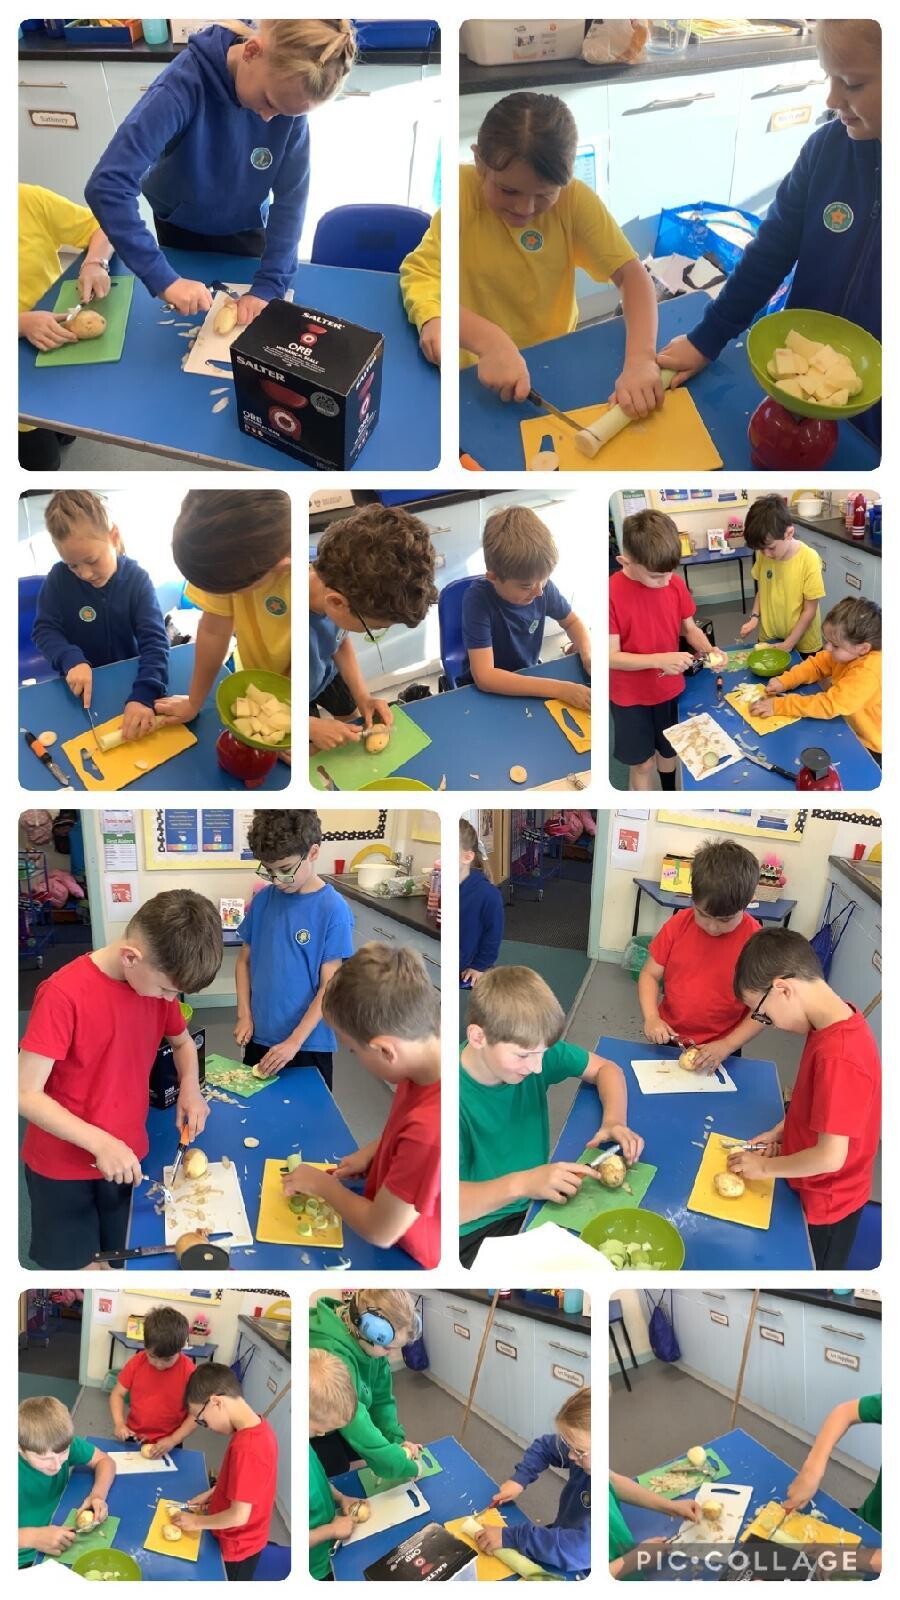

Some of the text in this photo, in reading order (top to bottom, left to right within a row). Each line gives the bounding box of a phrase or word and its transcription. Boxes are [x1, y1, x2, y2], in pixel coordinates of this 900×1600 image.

[301, 312, 342, 330] SALTER
[288, 342, 313, 356] ORB
[236, 355, 286, 382] SALTER
